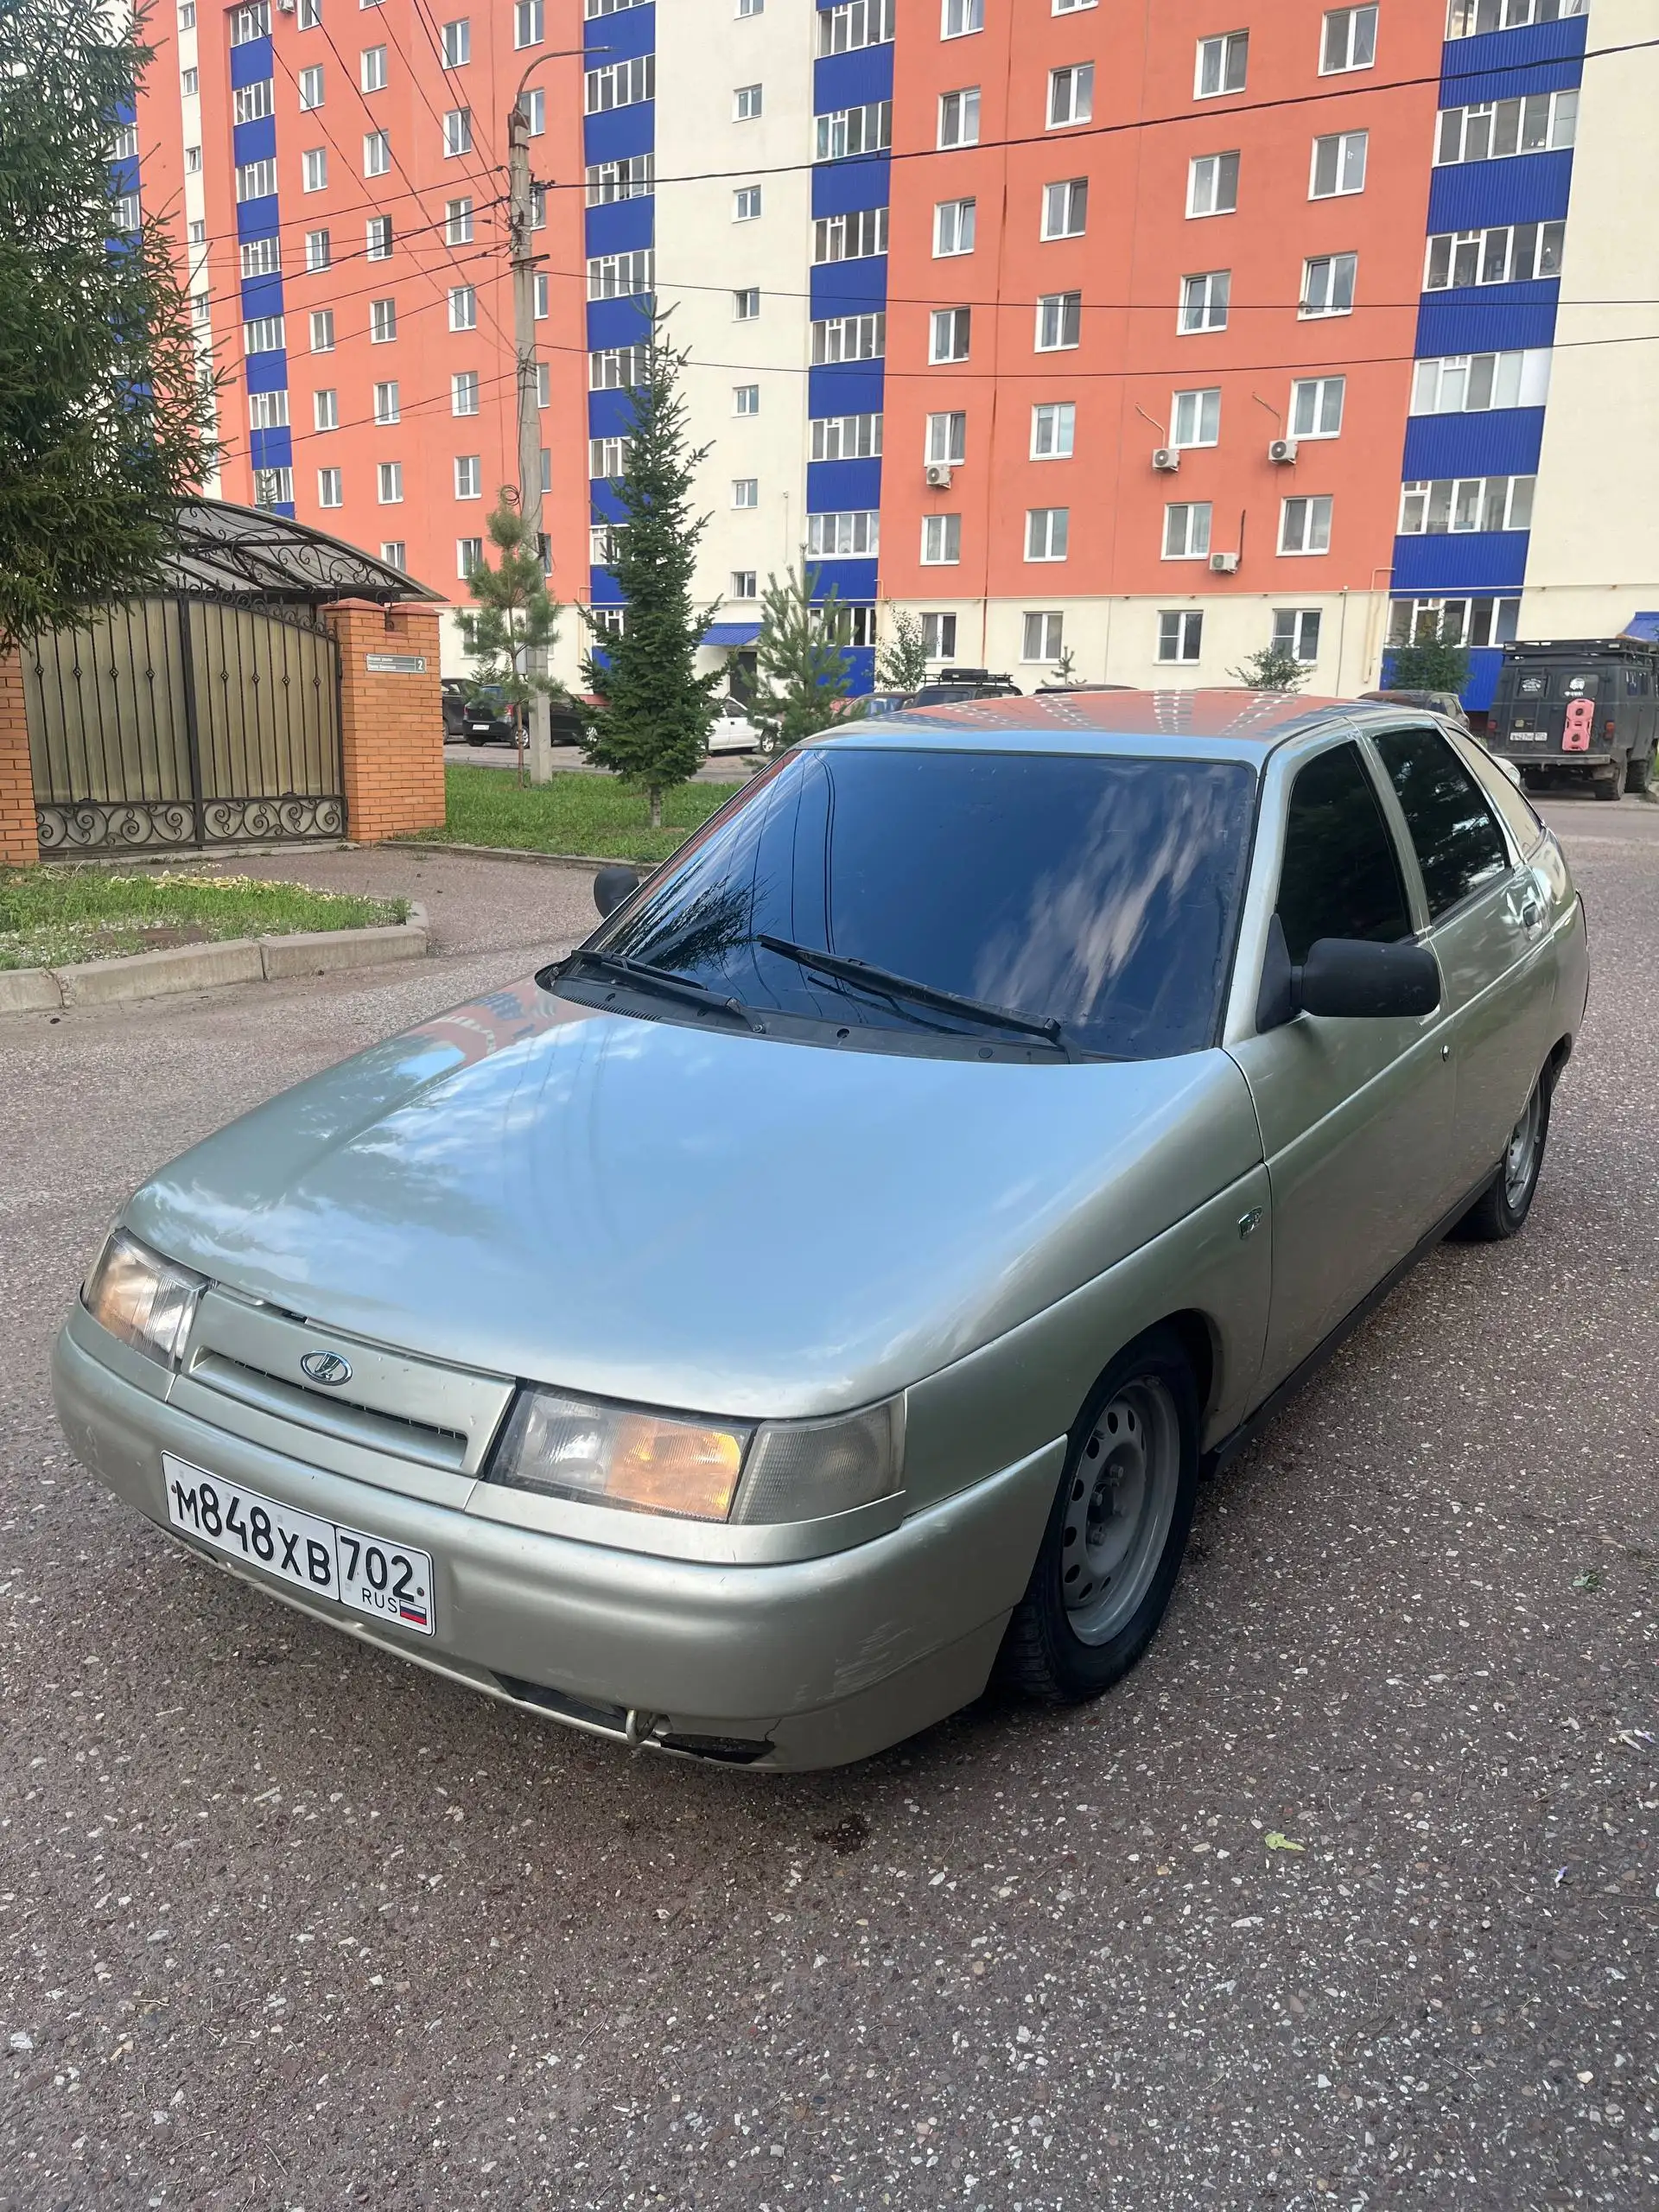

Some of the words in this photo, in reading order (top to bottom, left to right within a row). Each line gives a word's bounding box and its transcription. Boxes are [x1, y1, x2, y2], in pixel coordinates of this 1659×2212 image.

[417, 660, 423, 671] 2
[340, 1535, 415, 1603] 702
[361, 1587, 398, 1614] RUS
